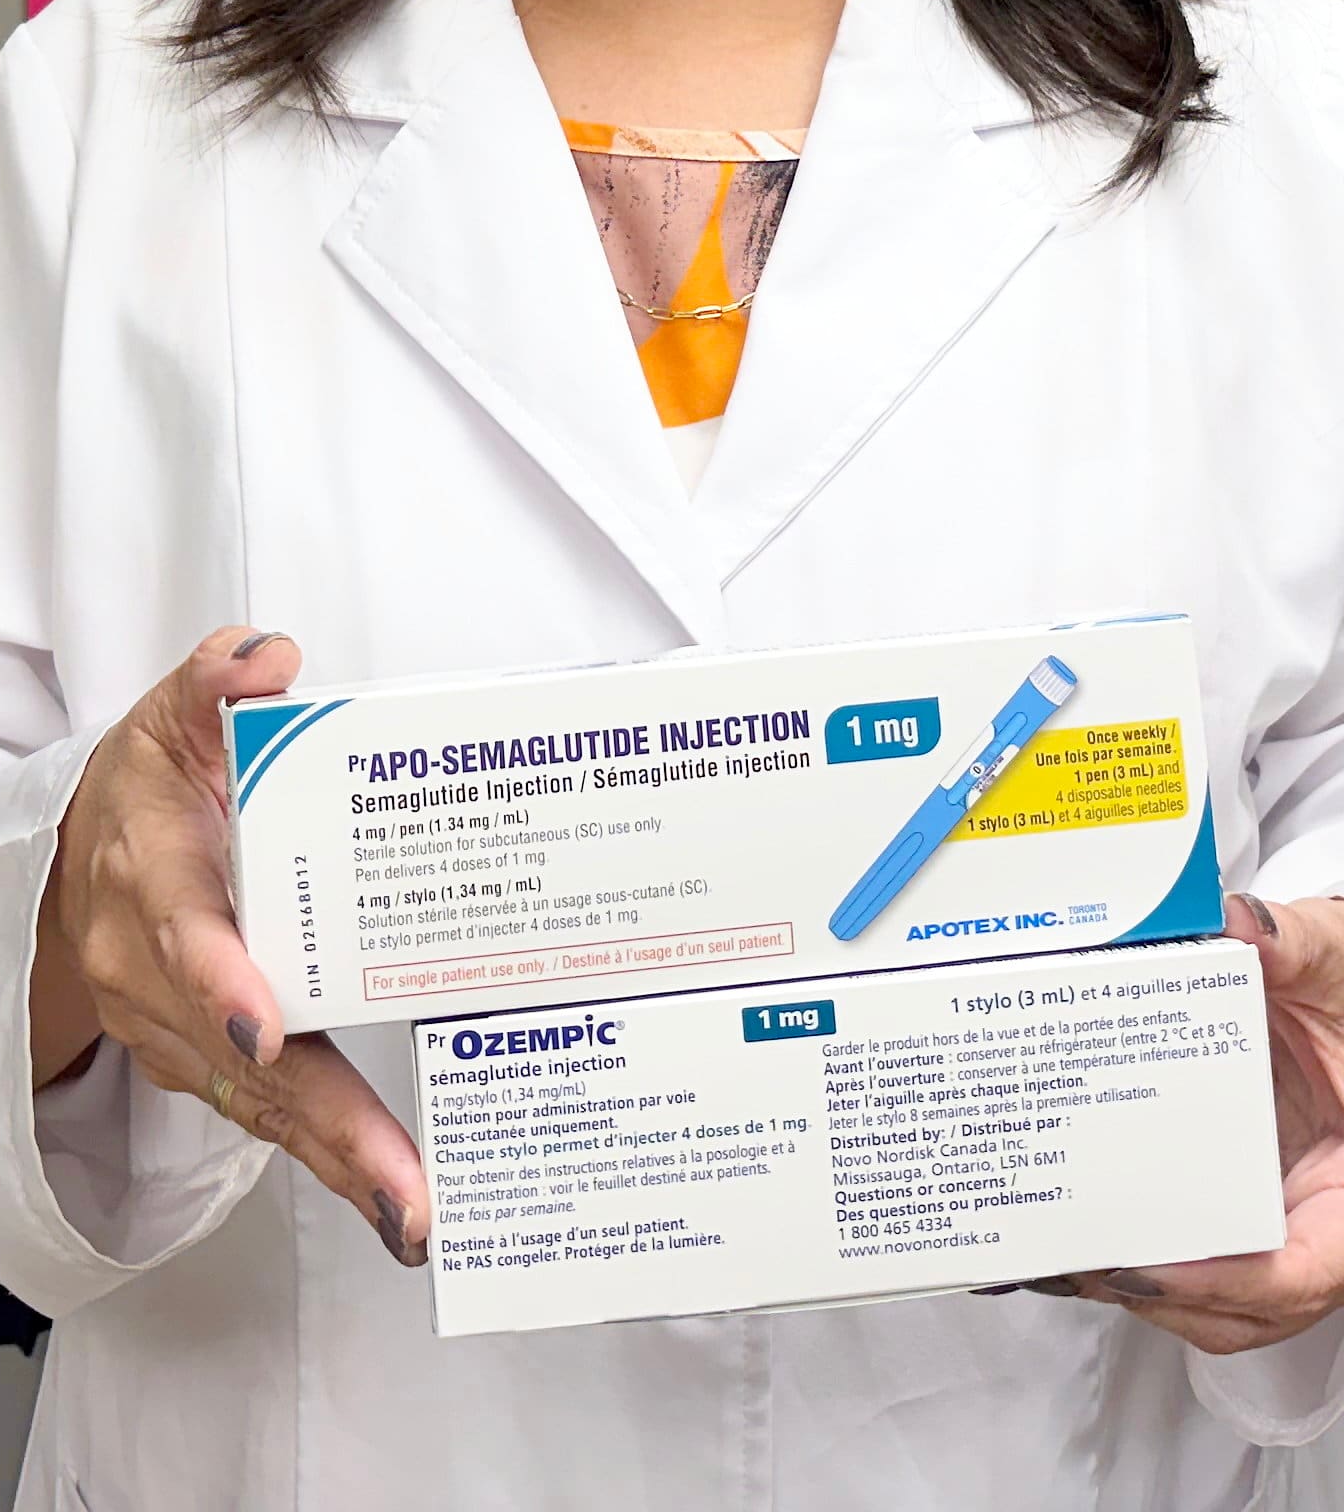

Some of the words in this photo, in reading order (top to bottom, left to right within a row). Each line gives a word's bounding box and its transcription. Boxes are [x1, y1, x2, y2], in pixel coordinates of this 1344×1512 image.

[659, 709, 810, 753] INJECTION
[846, 716, 862, 746] 1
[874, 716, 919, 748] mg
[1086, 730, 1119, 745] Once
[1121, 724, 1167, 742] weekly
[1034, 752, 1061, 767] Une
[1064, 748, 1089, 764] fois
[1092, 748, 1114, 765] par
[350, 782, 479, 815] Semaglutide
[486, 773, 573, 803] Injection
[579, 769, 587, 793] /
[592, 757, 718, 789] Sémaglutide
[725, 749, 810, 779] injection
[1054, 789, 1064, 804] 4
[1066, 783, 1133, 805] disposable
[1135, 779, 1182, 796] needles
[353, 844, 396, 863] Sterile
[398, 840, 453, 858] solution
[456, 836, 476, 851] for
[478, 827, 571, 849] subcutaneous
[574, 821, 604, 842] (SC)
[607, 821, 631, 836] use
[294, 854, 318, 952] 02568012
[1068, 902, 1107, 916] TORONTO
[906, 916, 1010, 942] APOTEX
[1016, 911, 1064, 930] INC.
[1068, 914, 1108, 926] CANADA
[371, 974, 395, 991] For
[397, 969, 438, 989] single
[441, 964, 488, 986] patient
[489, 963, 514, 978] use
[561, 950, 611, 970] Destiné
[613, 948, 623, 964] à
[625, 945, 673, 963] l'usage
[675, 941, 705, 958] d'un
[707, 936, 735, 954] seul
[306, 963, 322, 998] DIN
[950, 996, 959, 1014] 1
[966, 991, 1012, 1015] stylo
[1017, 989, 1035, 1010] (3
[1041, 984, 1075, 1005] mL)
[1080, 987, 1097, 1001] et
[1101, 983, 1112, 998] 4
[1115, 977, 1182, 1000] aiguilles
[1186, 972, 1248, 995] jetables
[758, 1008, 774, 1029] 1
[778, 1006, 820, 1030] mg
[428, 1032, 446, 1049] Pr
[429, 1060, 542, 1087] sémaglutide
[547, 1053, 626, 1078] injection
[831, 1153, 872, 1169] Novo
[876, 1144, 936, 1164] Nordisk
[939, 1138, 997, 1157] Canada
[999, 1153, 1029, 1170] L5N
[1033, 1149, 1066, 1167] 6M1
[834, 1186, 913, 1206] Questions
[916, 1184, 934, 1196] or
[937, 1176, 1007, 1194] concerns
[440, 1235, 495, 1253] Destiné
[498, 1234, 508, 1248] à
[511, 1231, 562, 1247] l'usage
[565, 1225, 597, 1241] d'un
[600, 1220, 630, 1238] seul
[633, 1217, 689, 1238] patient.
[838, 1226, 845, 1241] 1
[850, 1223, 879, 1240] 800
[882, 1219, 911, 1235] 465
[915, 1215, 953, 1232] 4334
[837, 1231, 1001, 1259] www.novonordisk.ca
